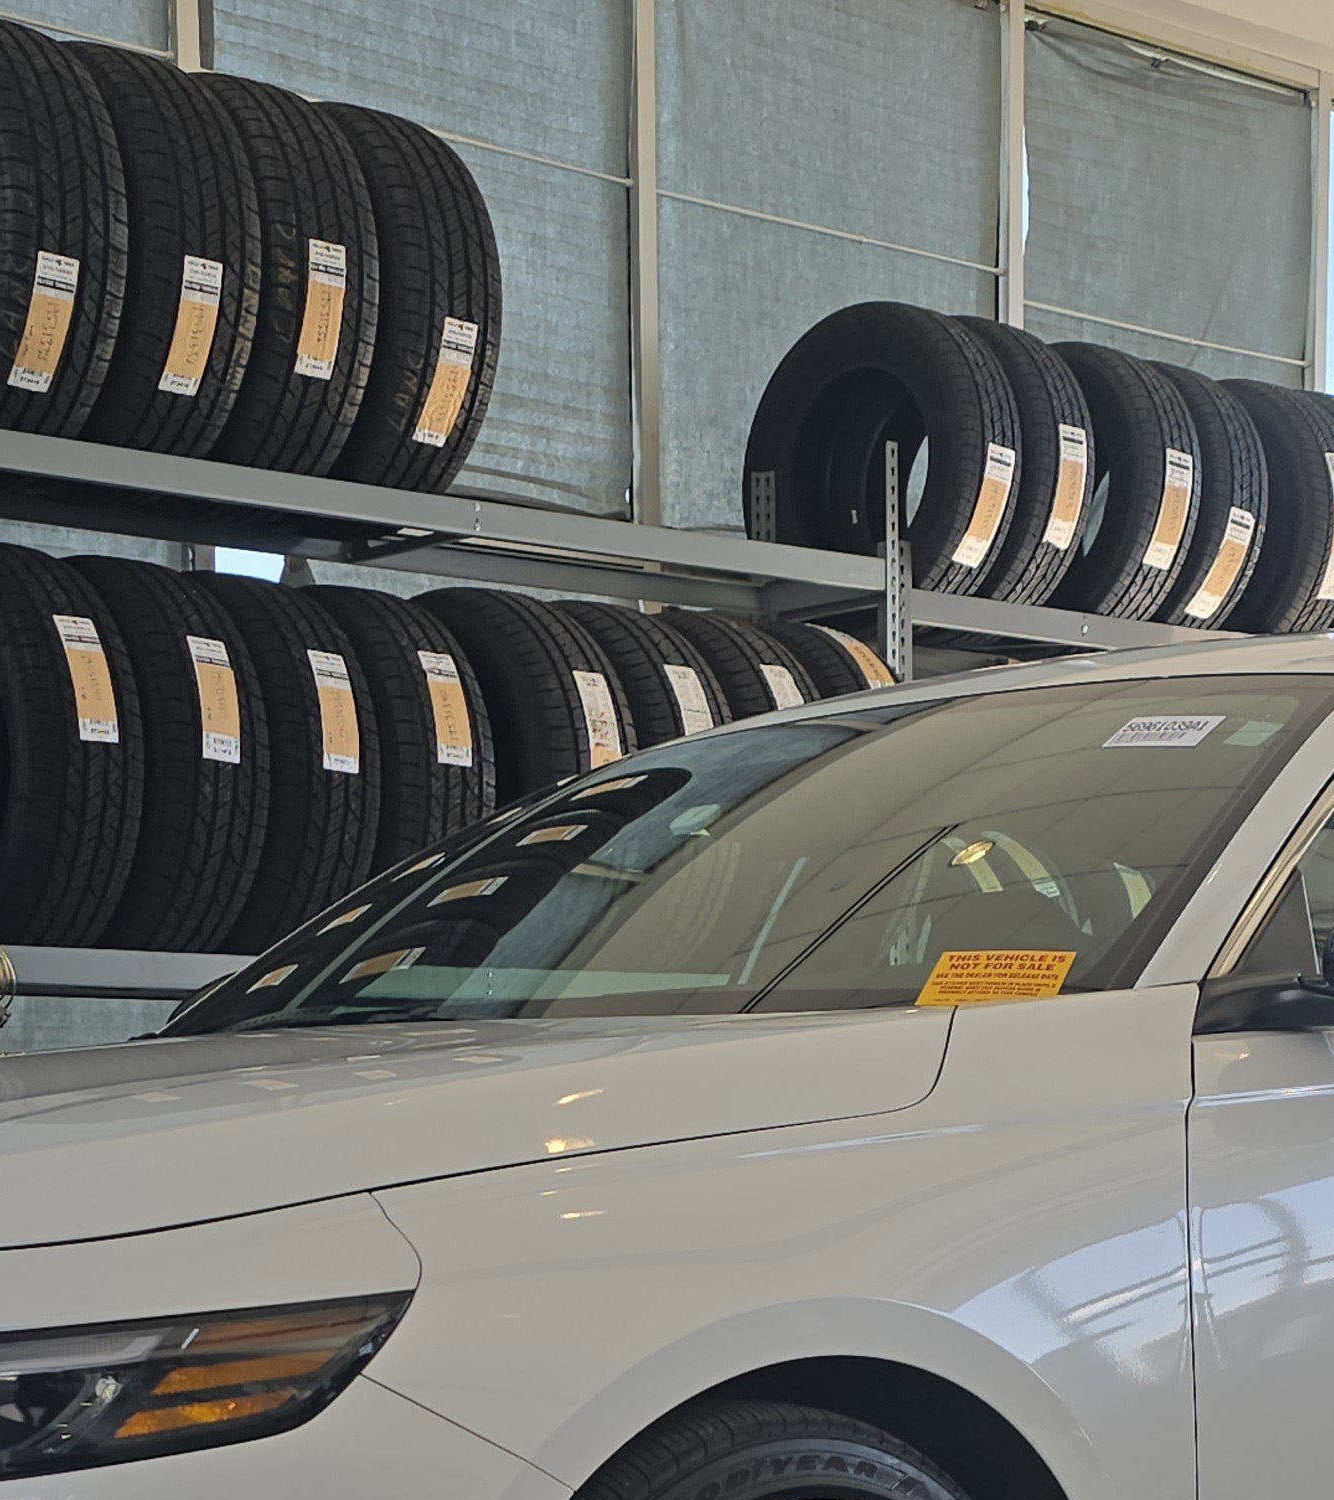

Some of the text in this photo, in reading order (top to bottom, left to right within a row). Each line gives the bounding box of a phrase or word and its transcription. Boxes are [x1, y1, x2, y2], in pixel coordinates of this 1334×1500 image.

[948, 954, 1068, 964] THIS VEHICLE IS
[1017, 963, 1056, 971] SALE
[1041, 973, 1060, 981] DATE
